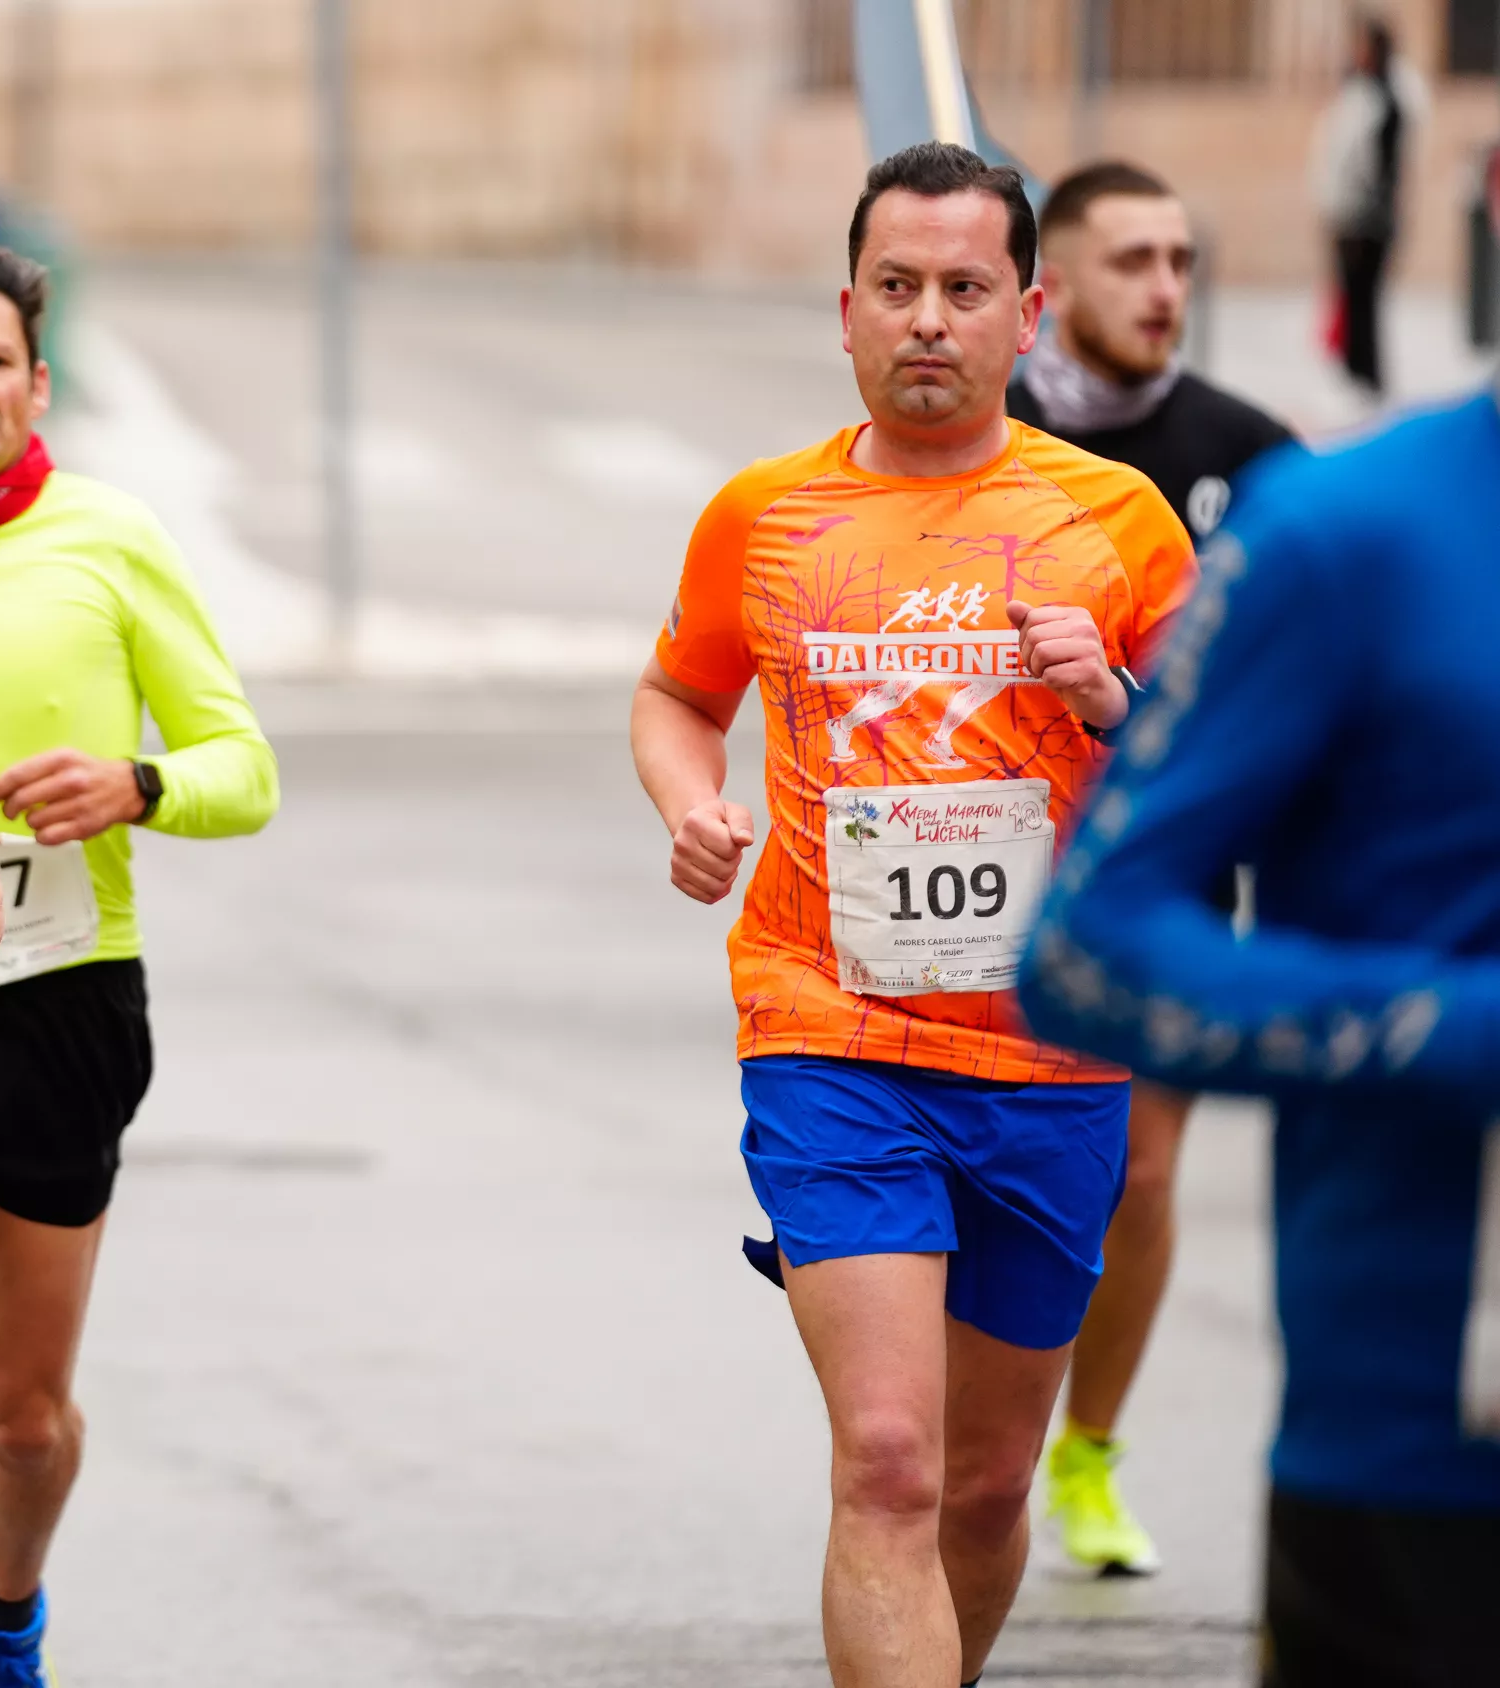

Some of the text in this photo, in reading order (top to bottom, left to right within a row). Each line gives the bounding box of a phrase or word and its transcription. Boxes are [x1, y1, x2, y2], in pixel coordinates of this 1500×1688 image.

[808, 644, 1031, 676] DATACONE
[887, 798, 910, 828] X
[915, 824, 992, 843] LUCENA
[0, 856, 31, 909] 7
[887, 862, 1007, 921] 109
[894, 935, 1002, 946] ANDRES CABELLO GALISTEO
[934, 948, 964, 957] L-Mujer
